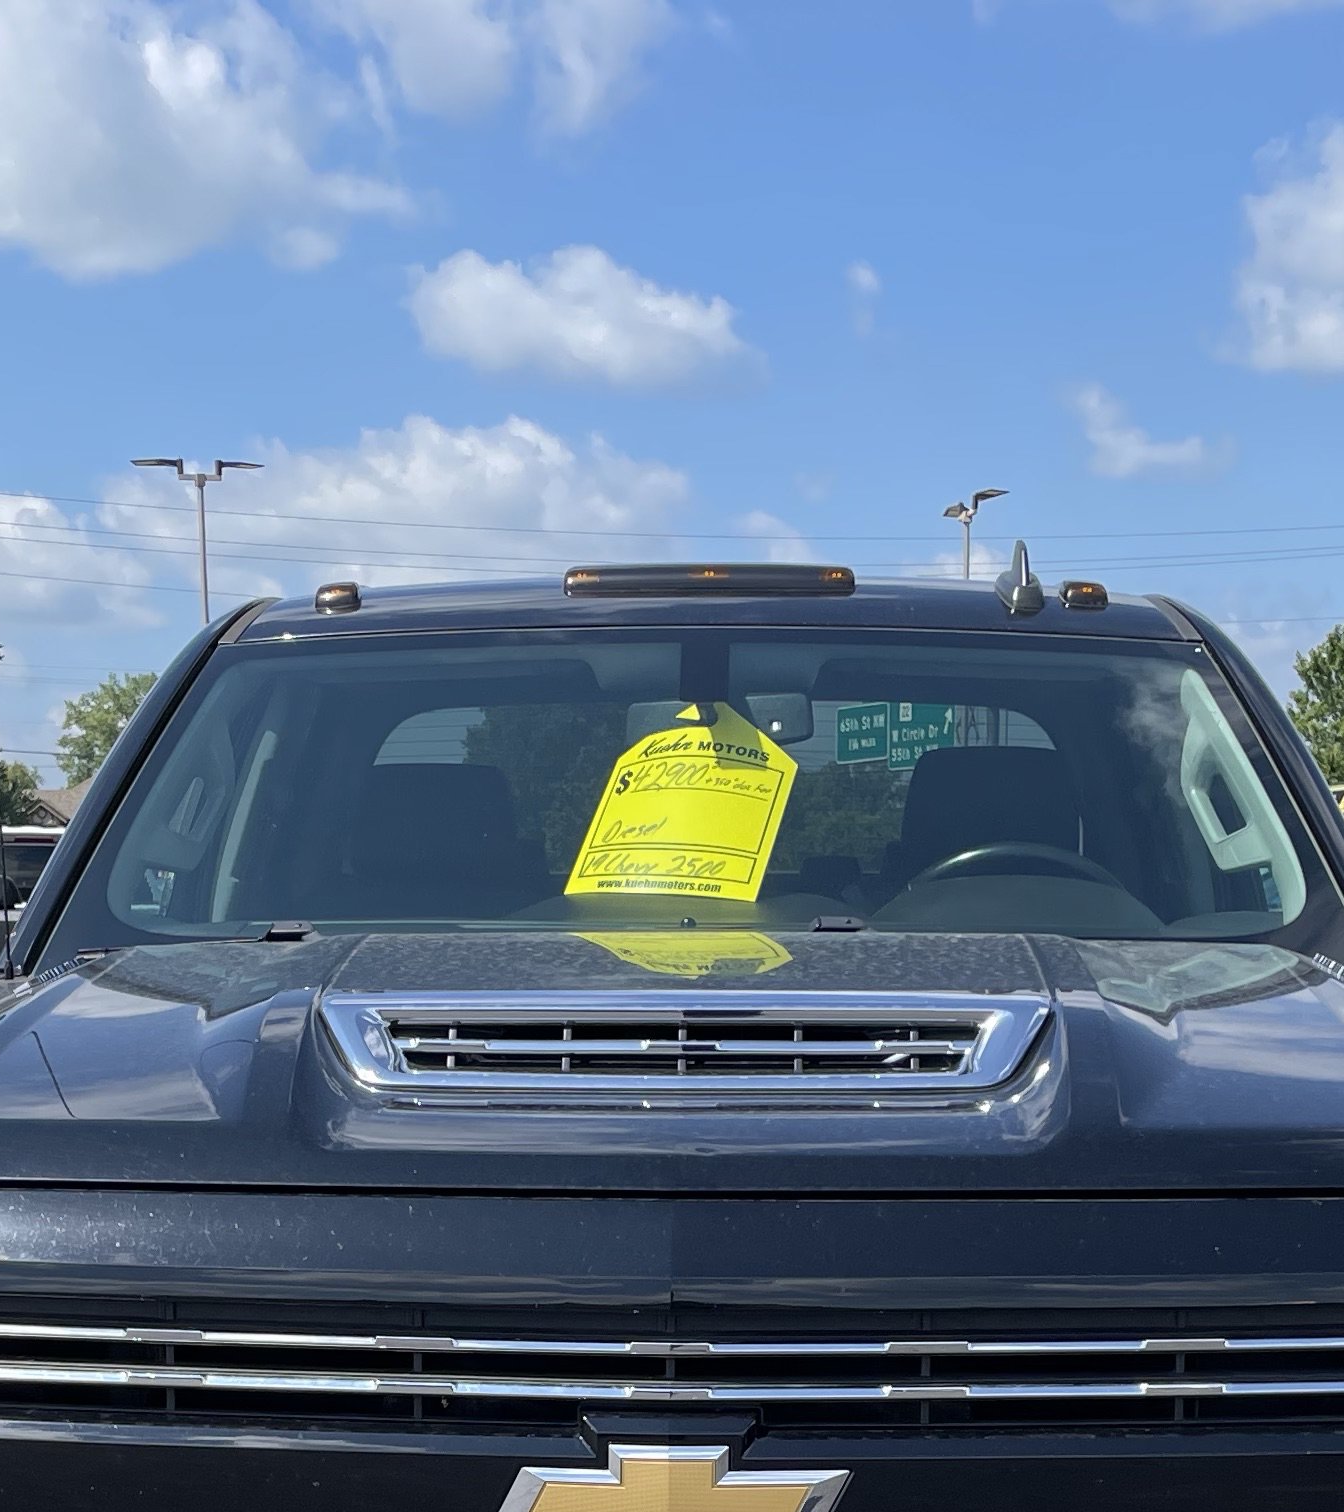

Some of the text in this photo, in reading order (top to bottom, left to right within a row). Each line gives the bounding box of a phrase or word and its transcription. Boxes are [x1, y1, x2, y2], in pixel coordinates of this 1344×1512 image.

[862, 715, 871, 730] St
[902, 727, 925, 741] Circle
[928, 724, 939, 738] Dr
[638, 734, 770, 763] Kuehn MOTORS
[891, 748, 911, 762] 55th
[914, 746, 923, 760] St
[602, 816, 668, 844] Diesel
[666, 855, 727, 877] 2500
[597, 878, 722, 893] www.kuehnmotors.com
